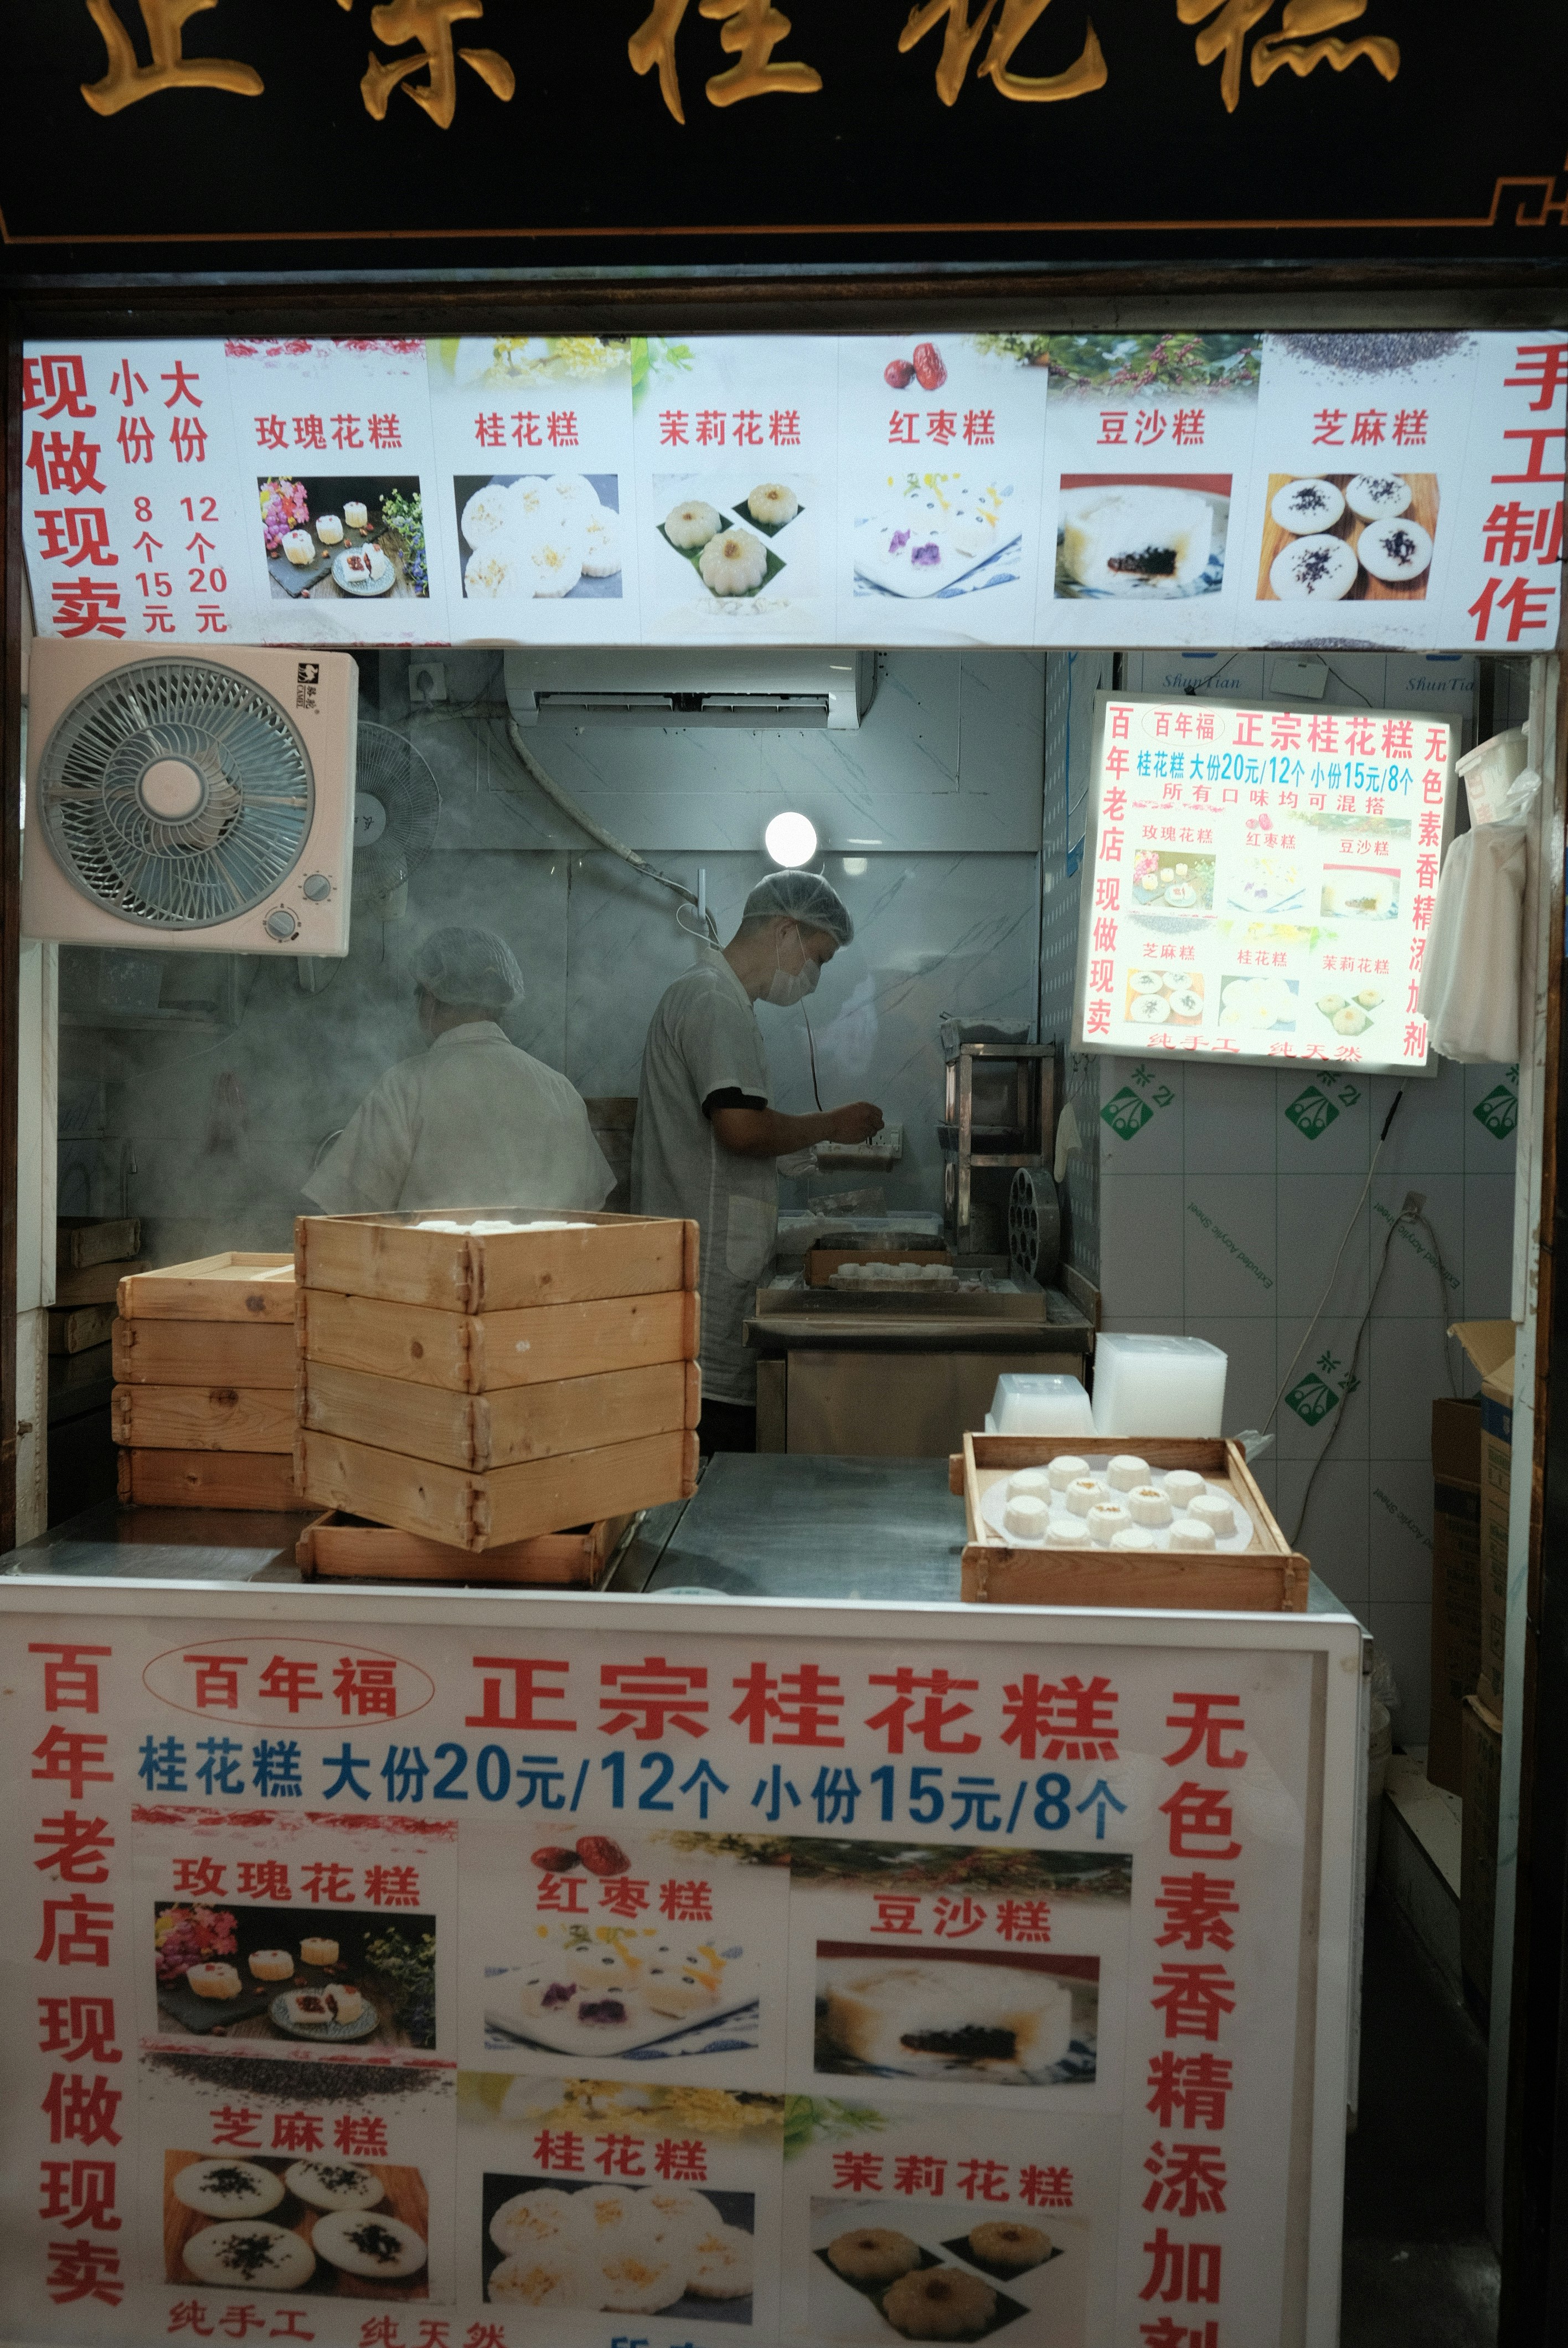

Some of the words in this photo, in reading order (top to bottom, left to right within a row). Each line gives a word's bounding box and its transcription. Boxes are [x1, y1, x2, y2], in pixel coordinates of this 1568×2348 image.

[110, 358, 155, 464] 小份
[160, 360, 208, 464] 大份
[474, 411, 579, 447] 桂花糕
[658, 409, 801, 446] 茉莉花糕
[888, 409, 996, 446] 红枣糕
[1096, 409, 1206, 446] 豆沙糕
[1312, 408, 1429, 446] 芝麻糕
[254, 414, 403, 450] 玫瑰花糕
[23, 354, 127, 639] 现做现卖
[1468, 343, 1567, 642] 手工制作
[296, 685, 304, 709] CAMEL
[1162, 673, 1241, 689] ShunTian
[1154, 712, 1215, 740] 百年福
[1232, 712, 1414, 759] 正宗桂花糕
[1099, 706, 1134, 862] 百年老店
[1137, 749, 1184, 779] 桂花糕
[1189, 752, 1305, 787] 大份20元/12个
[1311, 761, 1414, 796] 小份15元/8个
[1162, 782, 1385, 815] 所有口味均可混搭
[1142, 825, 1213, 844] 玫瑰花糕
[1245, 832, 1296, 849] 红枣糕
[1339, 839, 1390, 856] 豆沙糕
[1087, 878, 1121, 1034] 现做现卖
[1142, 943, 1195, 961] 芝麻糕
[1236, 949, 1288, 967] 桂花糕
[1322, 954, 1390, 975] 茉莉花糕
[1147, 1032, 1241, 1053] 纯手工
[1267, 1041, 1363, 1062] 纯天然
[1188, 1203, 1212, 1228] Sheet
[1211, 1226, 1239, 1253] Acrylic
[1397, 1226, 1425, 1254] Acrylic
[1236, 1252, 1273, 1289] Extruded
[183, 1654, 397, 1717] 百年福
[465, 1656, 1120, 1762] 正宗桂花糕
[28, 1642, 115, 1967] 百年老店
[138, 1734, 303, 1798] 桂花糕
[322, 1742, 730, 1820] 大份20元/12个
[751, 1765, 1128, 1840] 小份15元/8个
[173, 1856, 421, 1907] 玫瑰花糕
[536, 1872, 713, 1922] 红枣糕
[870, 1894, 1051, 1943] 豆沙糕
[209, 2106, 389, 2157] 芝麻糕
[38, 1996, 124, 2307] 现做现卖
[533, 2130, 708, 2182] 桂花糕
[832, 2151, 1074, 2208] 茉莉花糕
[167, 2299, 316, 2342] 纯手工
[359, 2314, 509, 2348] 纯天然
